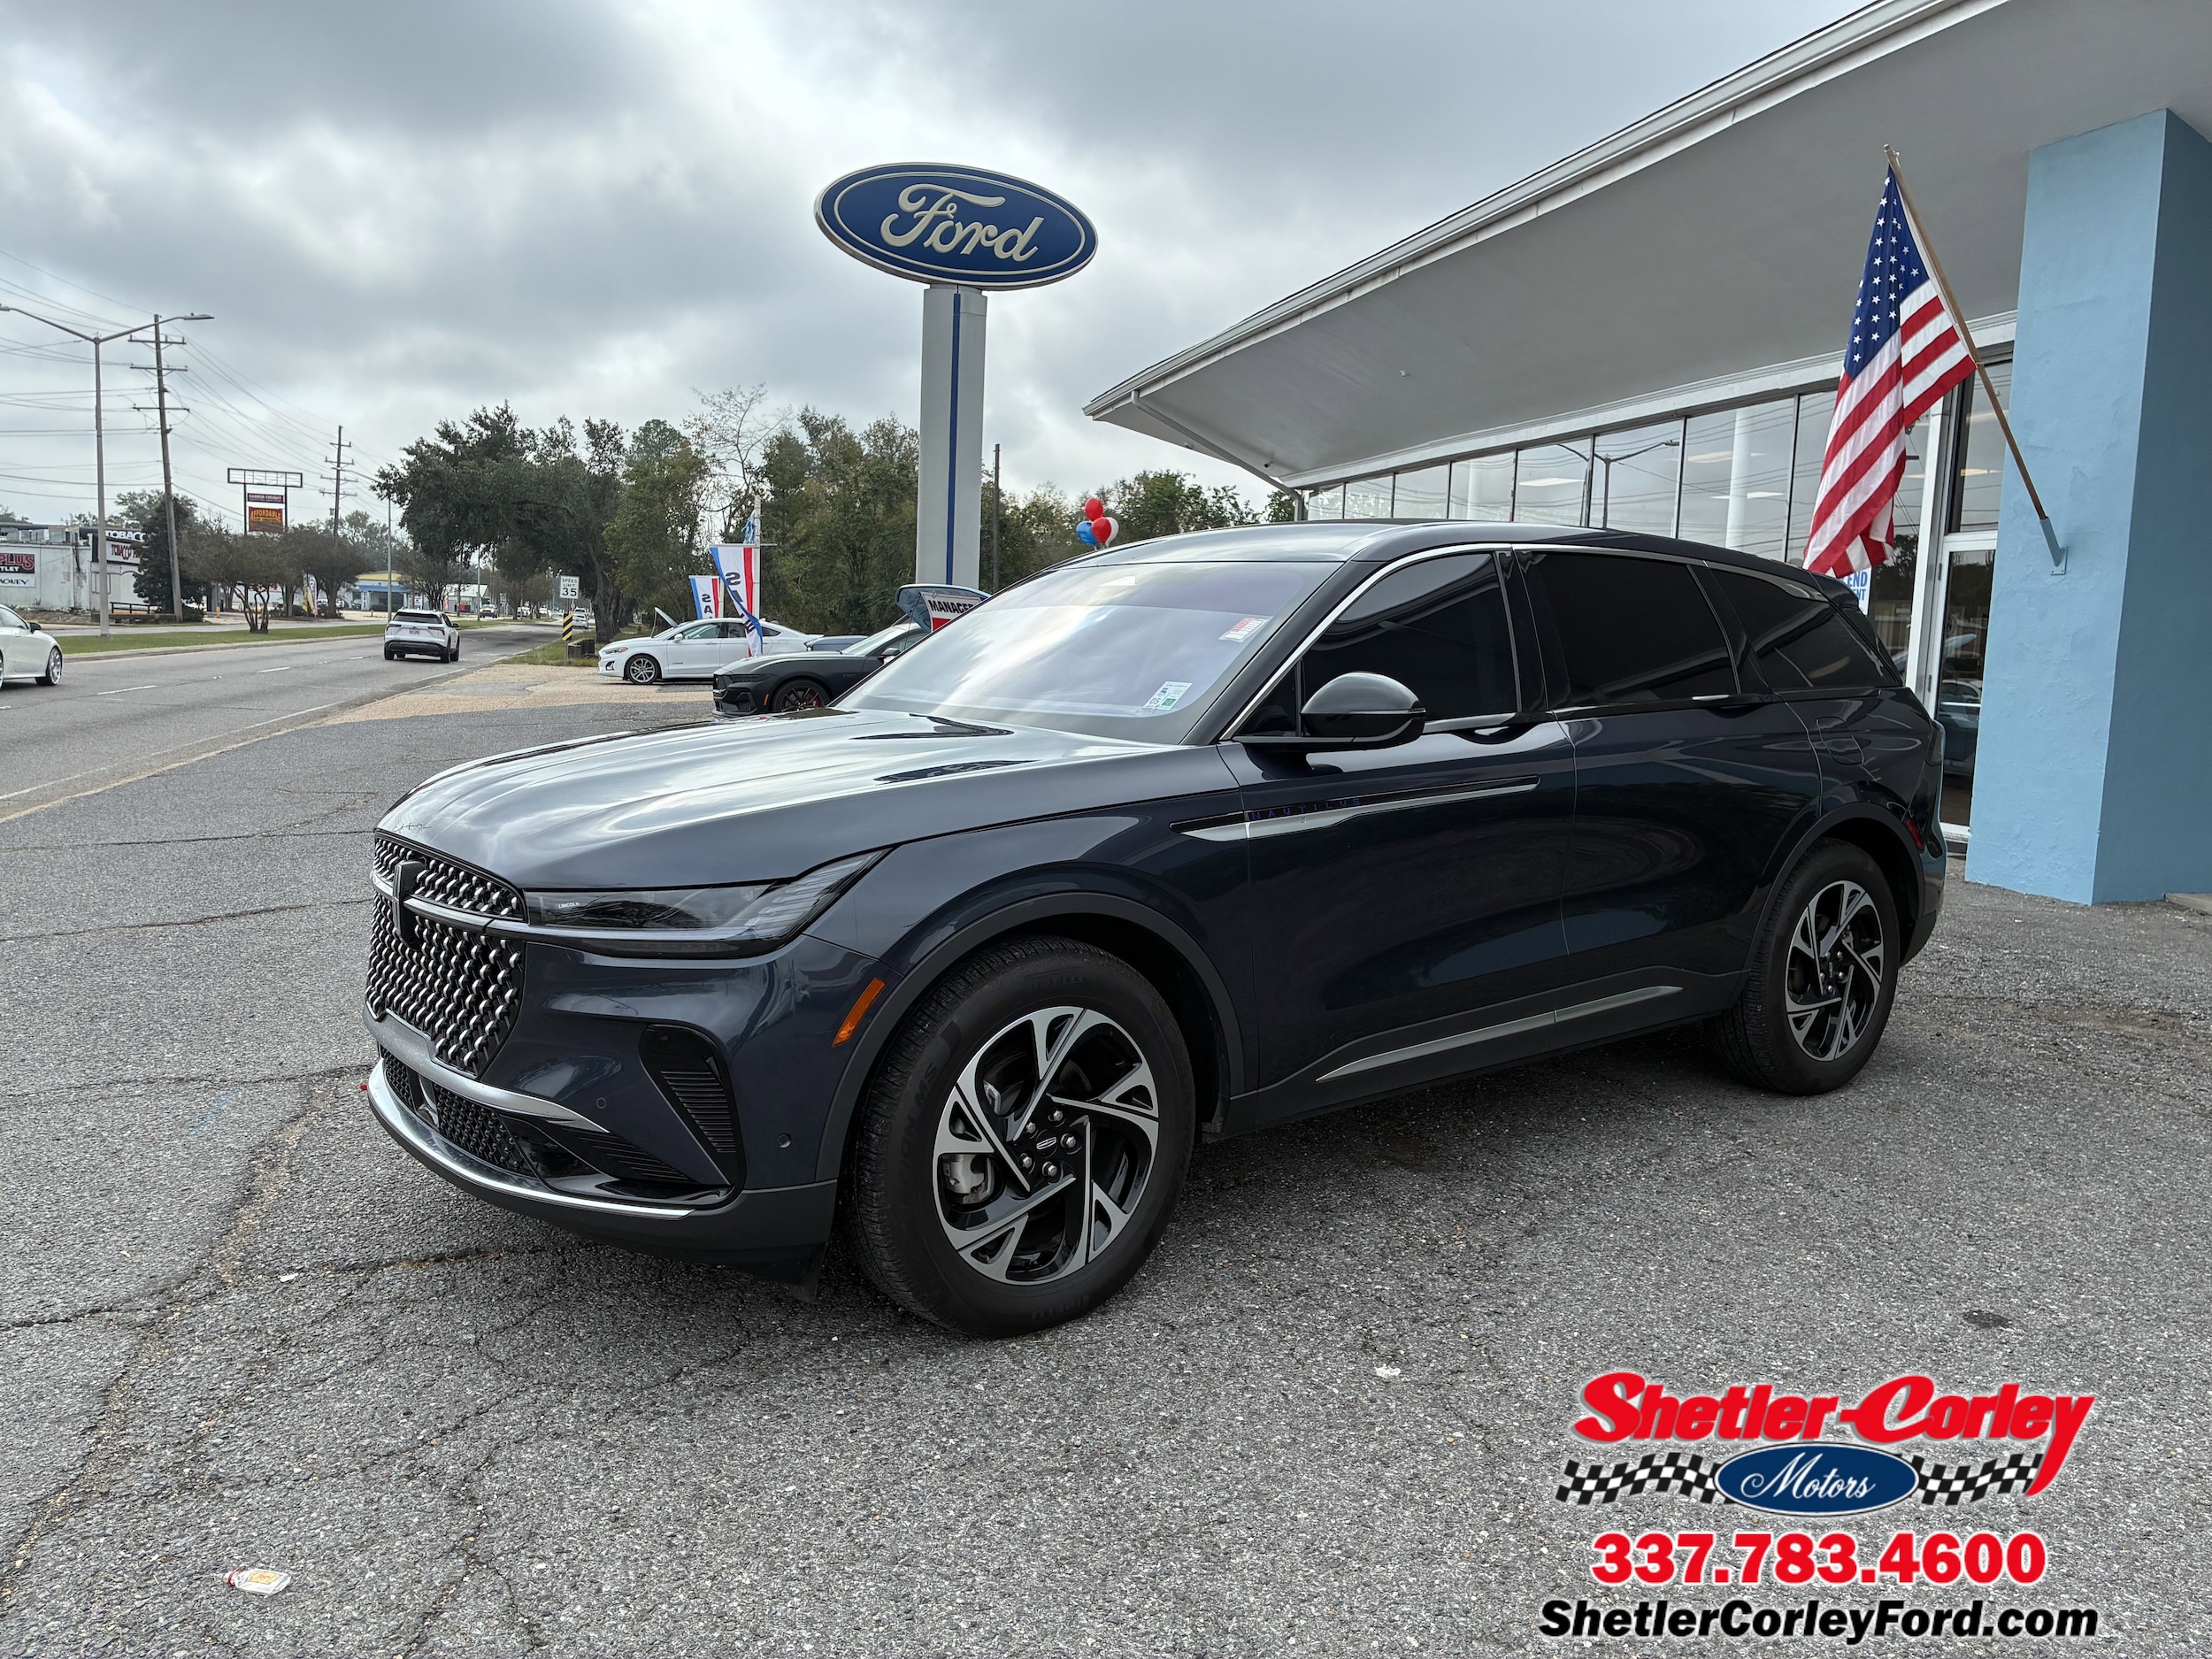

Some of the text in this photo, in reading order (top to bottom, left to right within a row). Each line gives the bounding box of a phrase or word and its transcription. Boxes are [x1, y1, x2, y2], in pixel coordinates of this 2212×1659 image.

[880, 183, 1044, 262] Ford
[250, 509, 281, 523] AFFORDABLE
[0, 553, 35, 571] PLUS
[562, 588, 577, 596] 35
[1251, 798, 1361, 820] NAUTILUS
